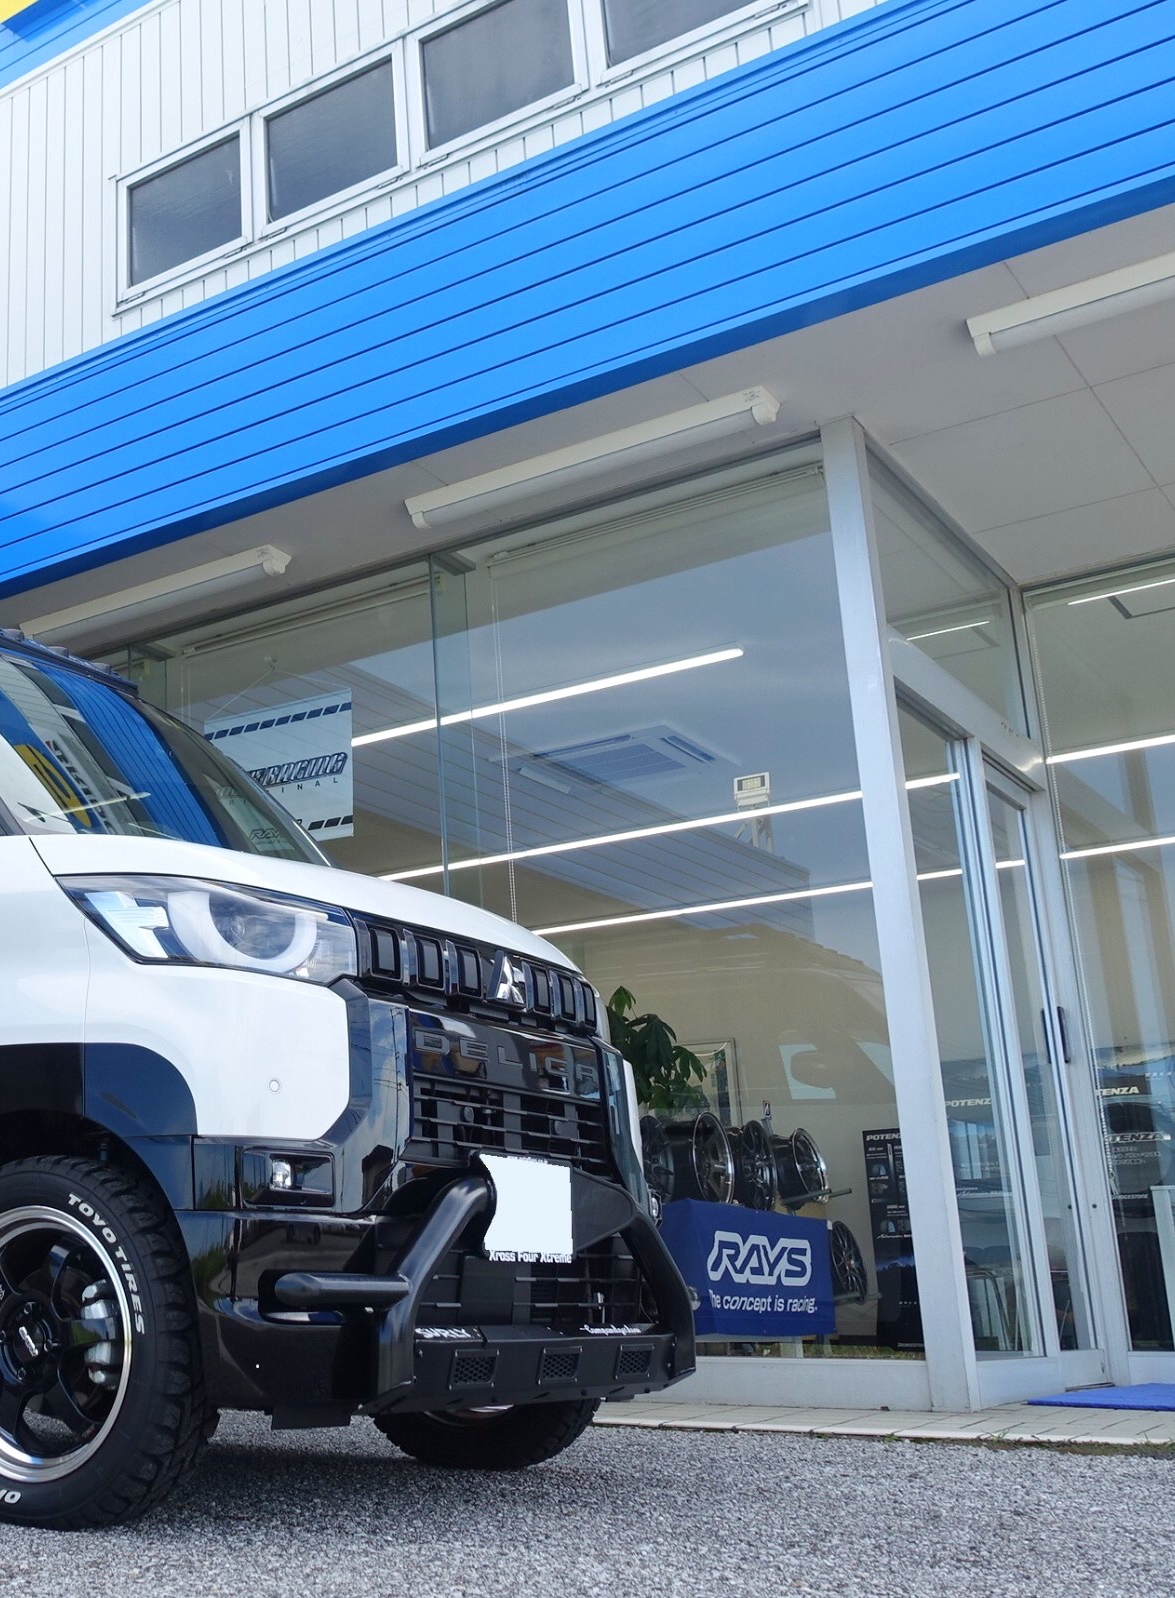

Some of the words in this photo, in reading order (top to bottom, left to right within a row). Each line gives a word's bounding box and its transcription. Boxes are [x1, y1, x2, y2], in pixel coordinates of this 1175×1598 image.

[267, 777, 338, 795] INAL
[248, 828, 280, 840] RAY
[414, 1030, 598, 1082] DELICA
[945, 1097, 992, 1107] POTENZ
[67, 1192, 117, 1244] TOYO
[113, 1249, 146, 1336] TIRES
[489, 1250, 516, 1261] Xross
[707, 1231, 812, 1286] RAYS
[722, 1294, 772, 1313] concept
[774, 1294, 784, 1312] is
[415, 1327, 472, 1339] SURLY
